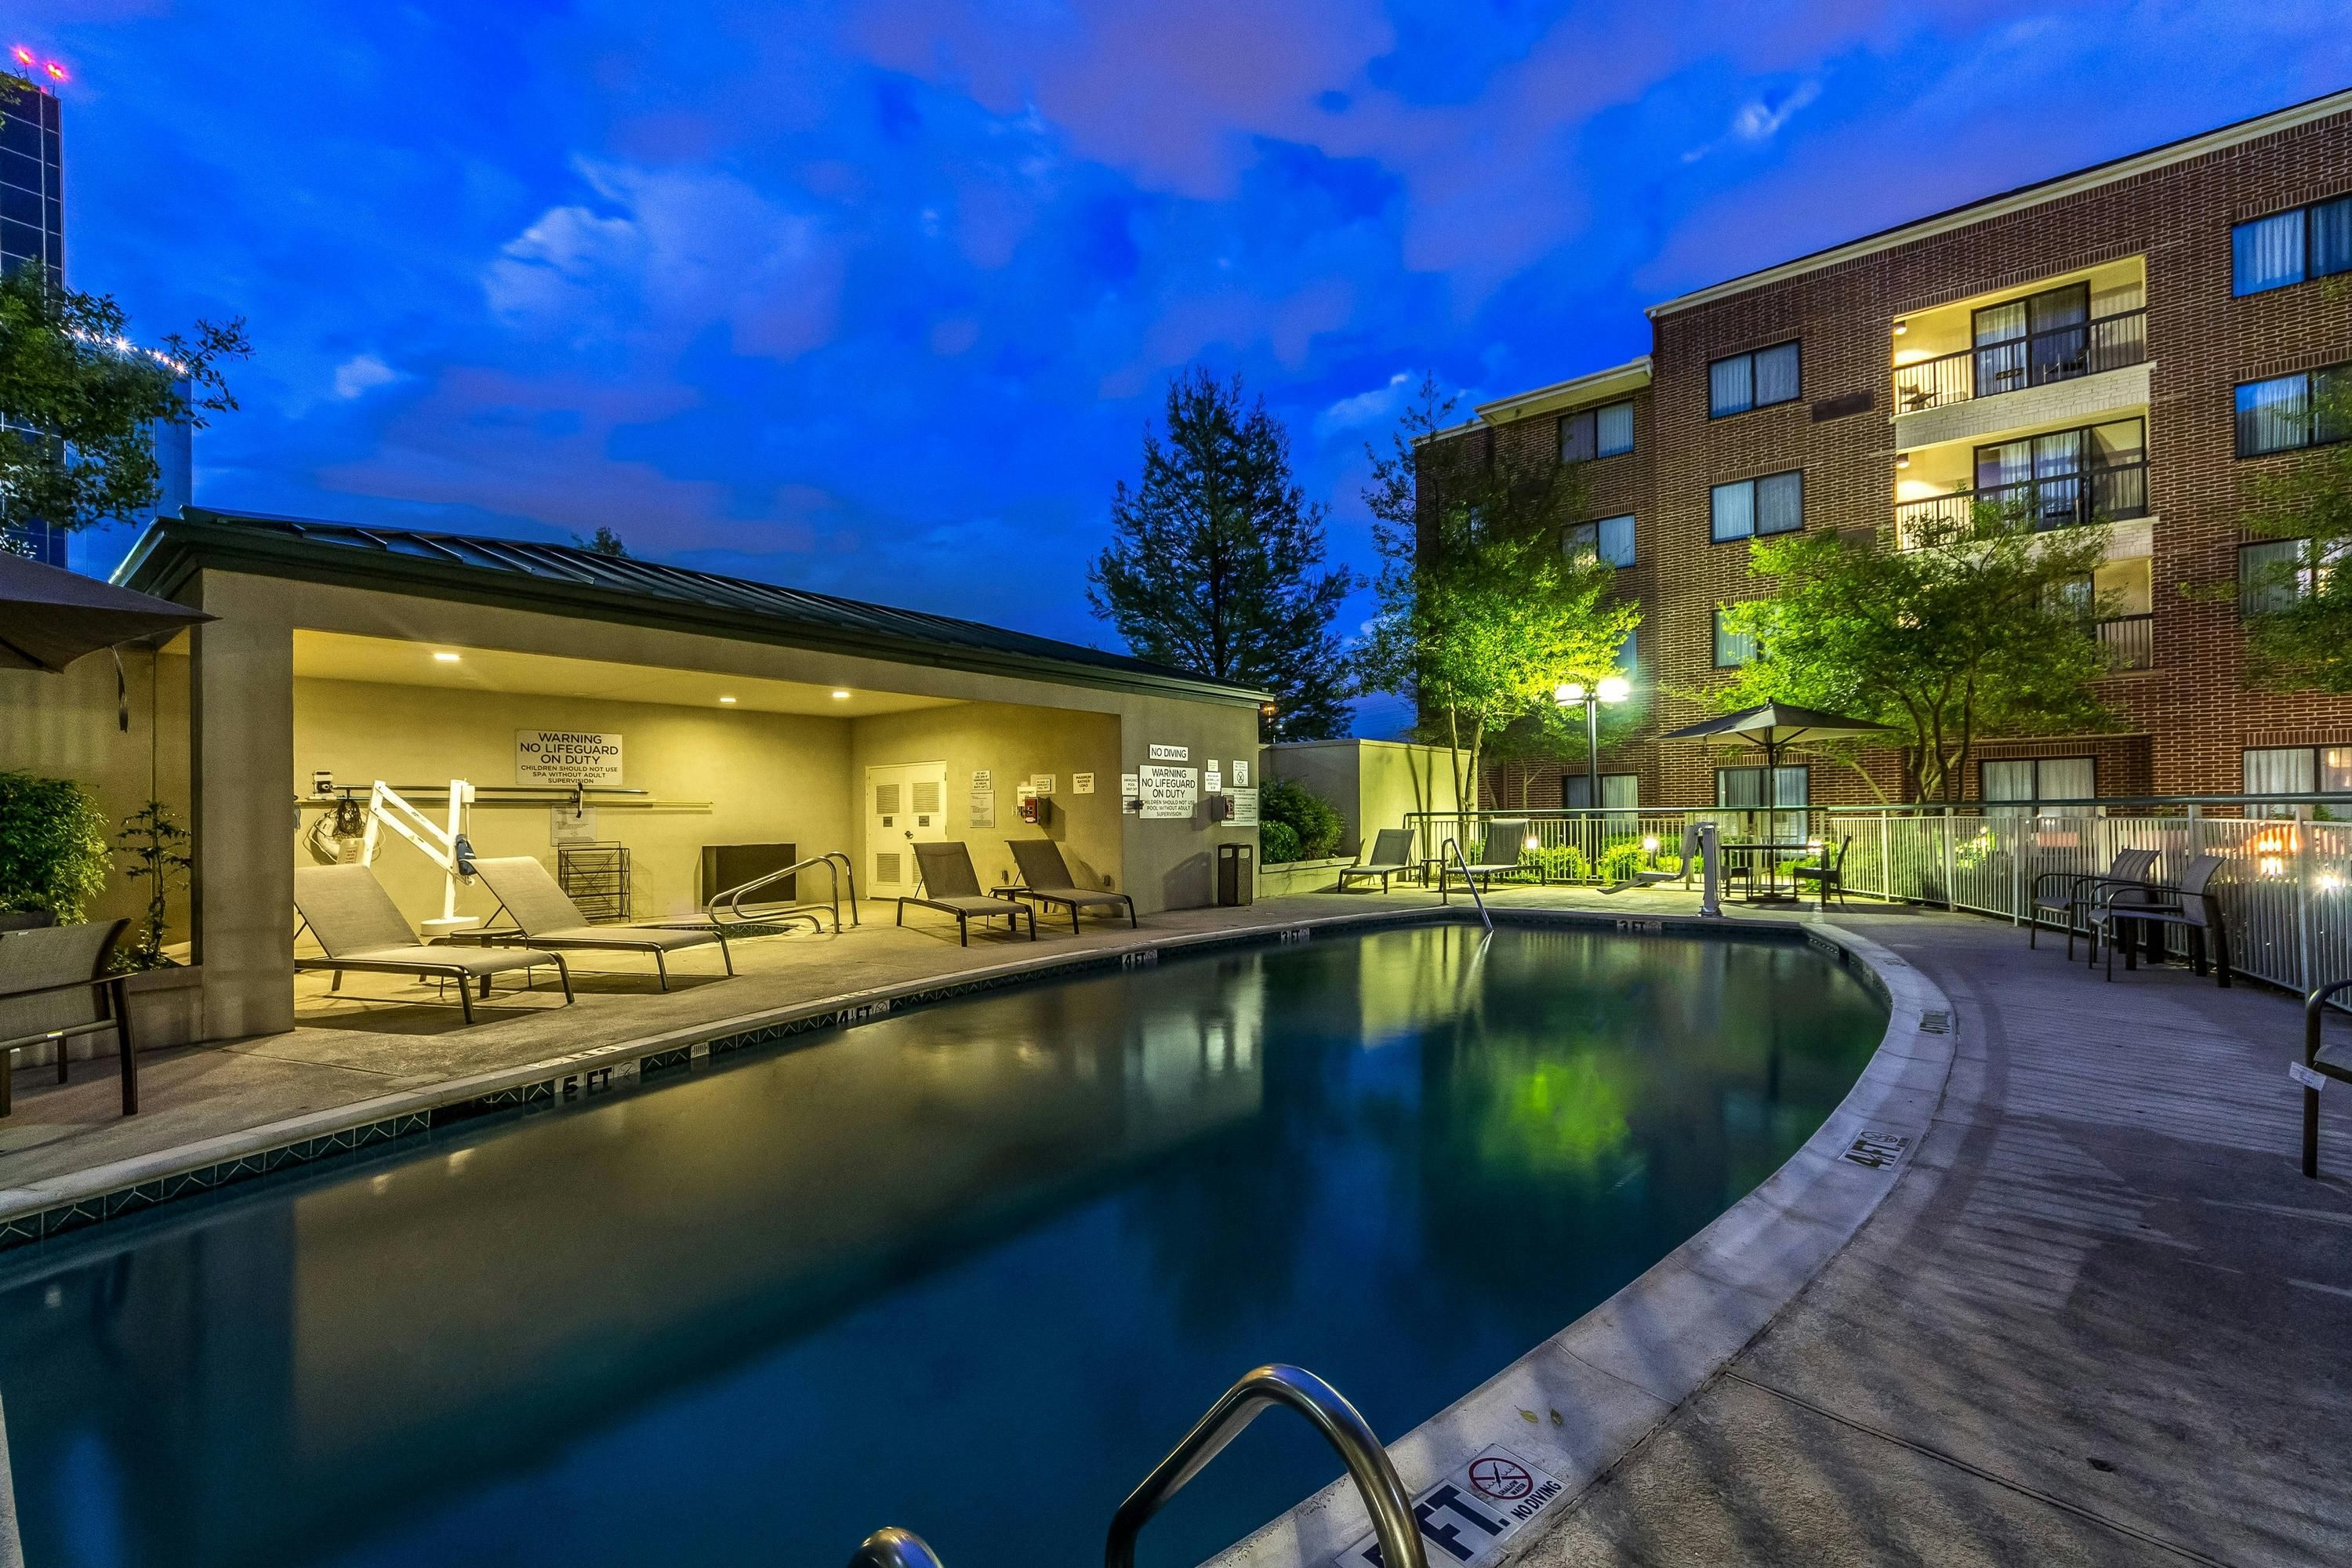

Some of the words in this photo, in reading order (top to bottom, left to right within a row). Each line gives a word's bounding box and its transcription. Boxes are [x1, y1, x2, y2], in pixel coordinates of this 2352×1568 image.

[538, 732, 602, 744] WARNING
[521, 742, 541, 752] NO
[546, 744, 618, 755] LIFEGUARD
[1152, 748, 1162, 756] NO
[1164, 749, 1186, 758] DIVING
[541, 754, 561, 764] ON
[566, 755, 600, 764] DUTY
[1152, 768, 1187, 778] WARNING
[1142, 778, 1153, 787] NO
[1155, 779, 1195, 788] LIFEGUARD
[1153, 789, 1163, 798] ON
[1166, 789, 1185, 798] DUTY
[856, 1005, 872, 1018] FT
[563, 1075, 578, 1094] 5
[587, 1067, 612, 1087] FT
[1497, 1479, 1519, 1495] SHALLOW
[1510, 1483, 1527, 1495] WATER
[1510, 1504, 1533, 1521] NO
[1523, 1480, 1562, 1510] DIVING
